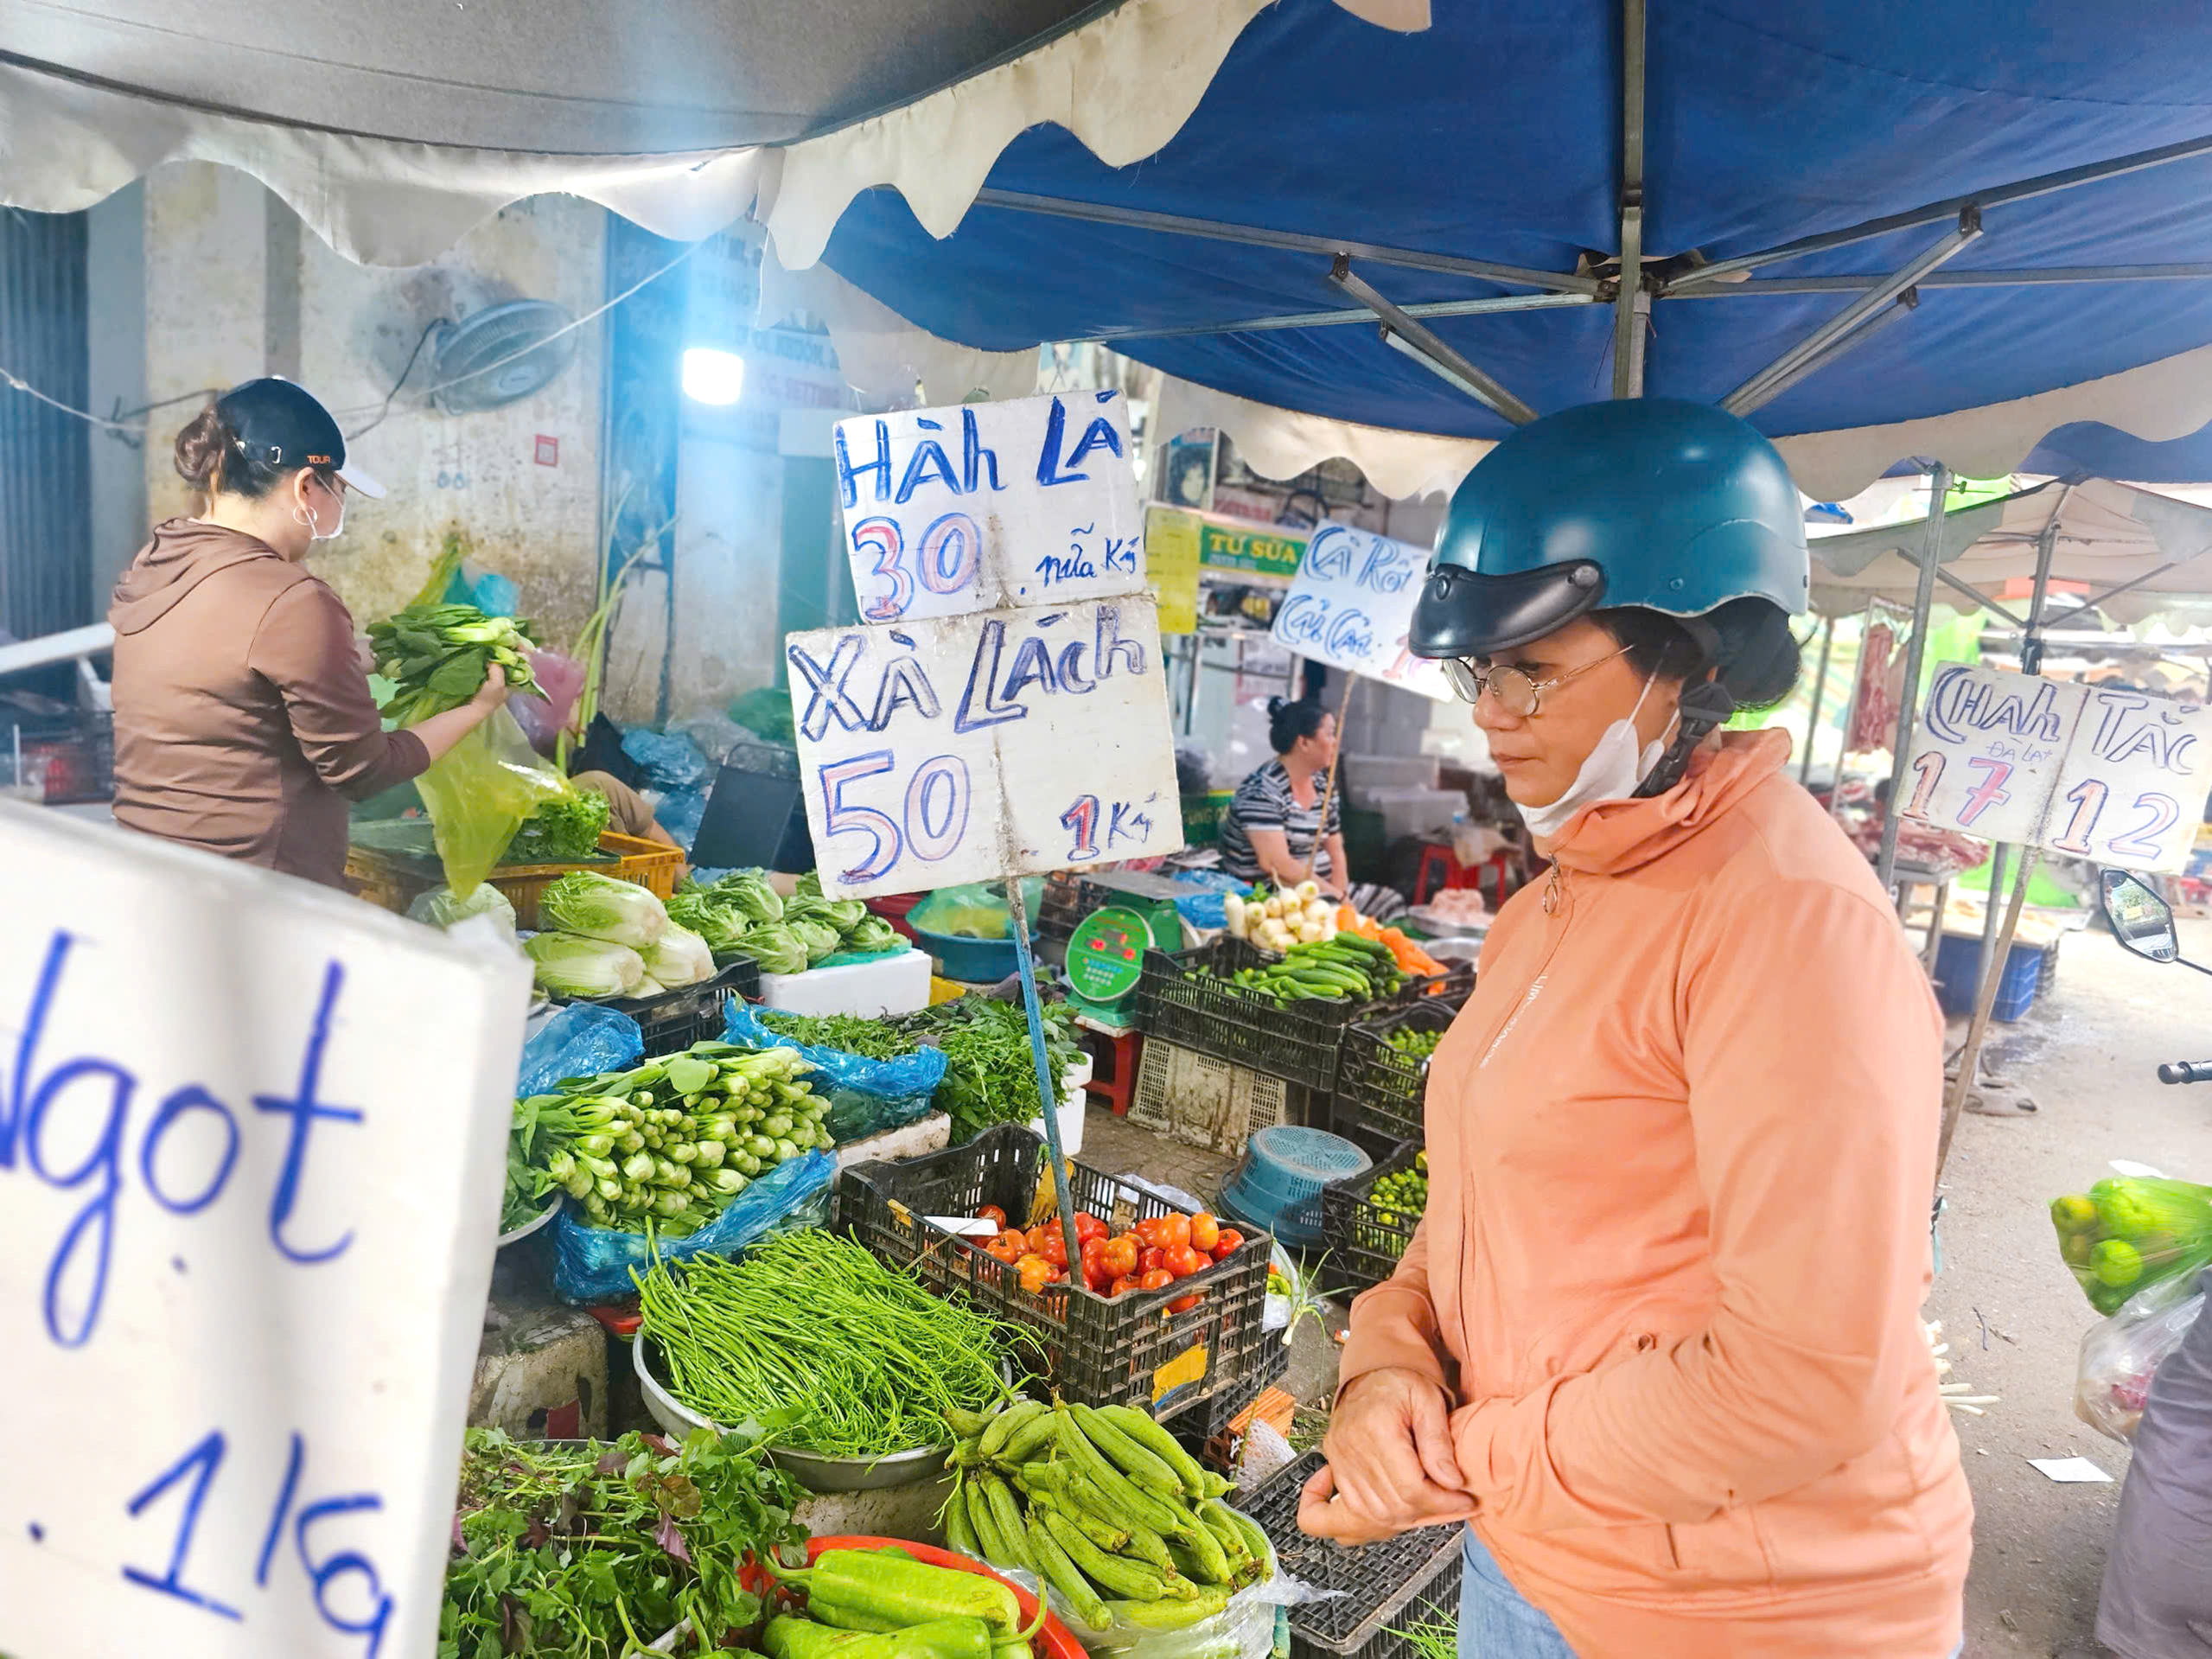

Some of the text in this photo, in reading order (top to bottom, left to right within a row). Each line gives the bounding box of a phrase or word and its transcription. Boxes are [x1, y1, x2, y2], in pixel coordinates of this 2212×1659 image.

[1036, 390, 1124, 486] LÁ
[851, 512, 983, 621] 30
[788, 630, 941, 743] XÀ
[1382, 634, 1438, 680] 1
[819, 748, 971, 885] 50
[1060, 794, 1100, 862] 1
[1902, 751, 2180, 860] 17 12
